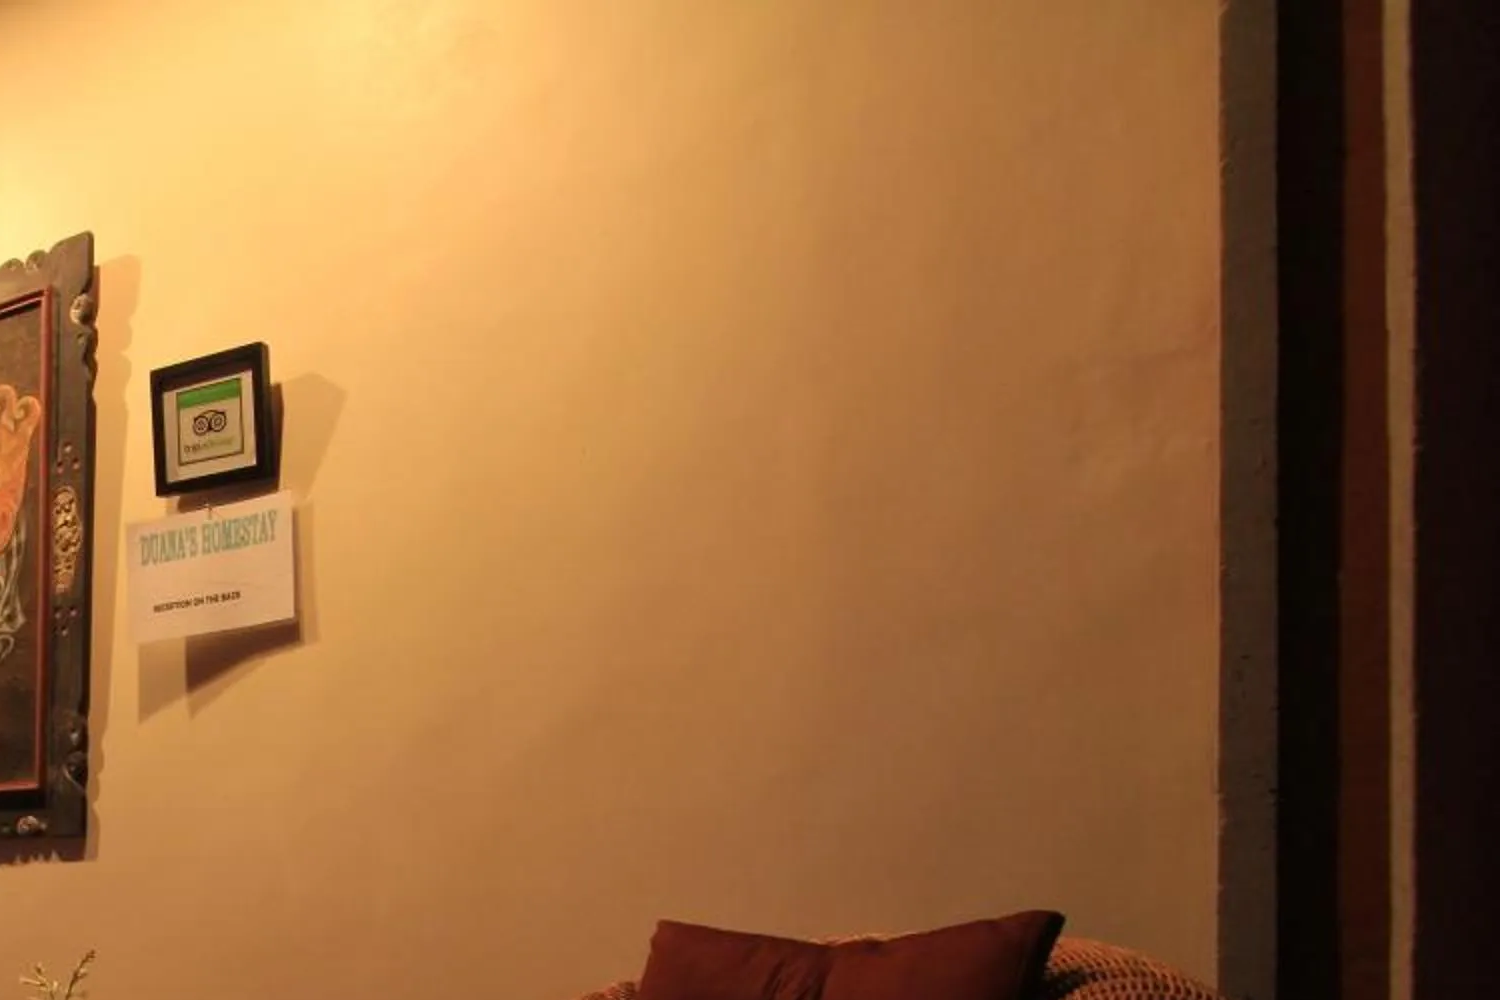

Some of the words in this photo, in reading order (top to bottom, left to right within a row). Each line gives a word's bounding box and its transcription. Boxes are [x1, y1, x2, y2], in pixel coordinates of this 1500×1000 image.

[202, 509, 277, 555] HOMESTAY
[193, 597, 204, 607] ON
[206, 594, 219, 605] THE
